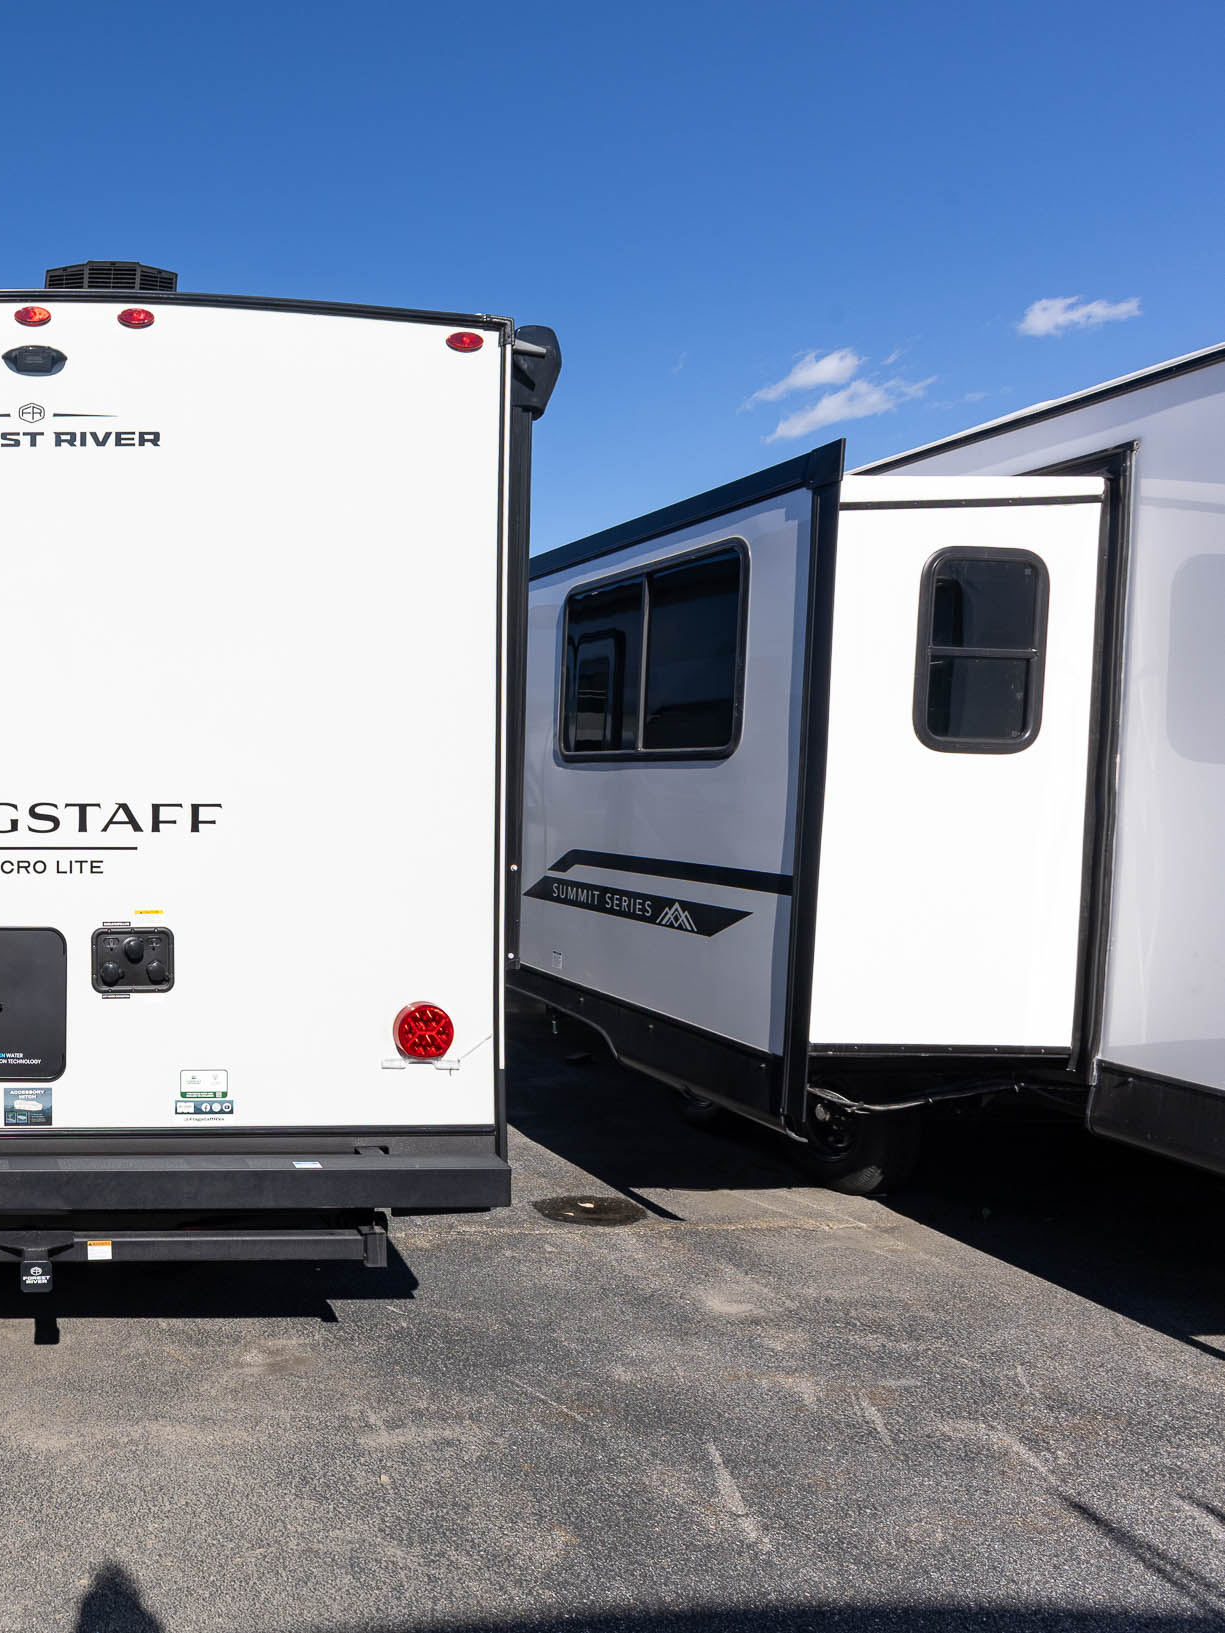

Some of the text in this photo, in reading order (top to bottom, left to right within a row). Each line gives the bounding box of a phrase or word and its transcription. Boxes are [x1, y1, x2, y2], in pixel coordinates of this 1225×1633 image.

[53, 431, 161, 447] RIVER
[56, 860, 104, 874] LITE
[552, 883, 652, 917] SUMMIT SERIES
